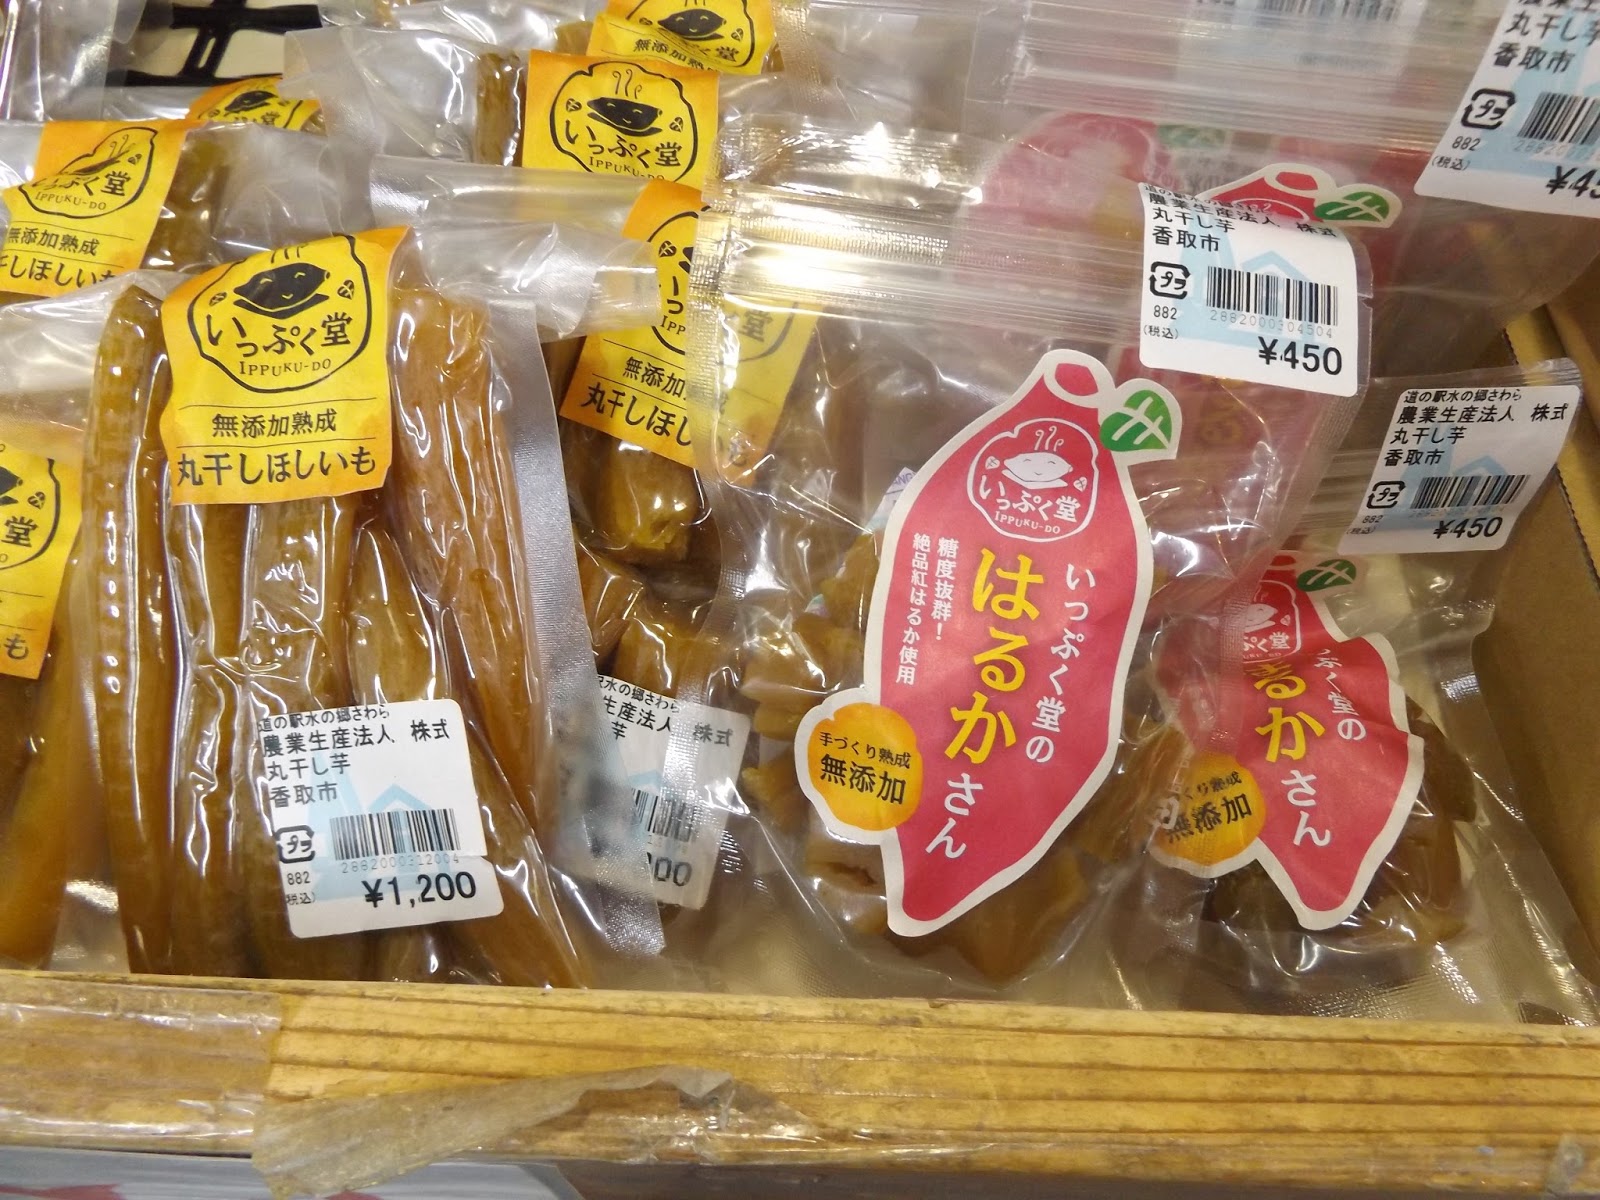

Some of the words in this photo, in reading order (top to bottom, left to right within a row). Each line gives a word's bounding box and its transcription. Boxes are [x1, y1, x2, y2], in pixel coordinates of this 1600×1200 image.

[634, 39, 718, 71] 無添加熟
[1494, 42, 1575, 73] 香取市
[565, 118, 682, 168] いっぷく堂
[1452, 136, 1481, 151] 882
[35, 191, 107, 211] IPPUKU-DO
[1152, 206, 1236, 233] 丸干し芋
[1152, 225, 1221, 252] 香取市
[1153, 305, 1178, 321] 882
[206, 312, 352, 357] いっぷく堂
[239, 358, 332, 377] IPPUKU-DO
[1258, 336, 1342, 376] ¥450
[622, 356, 688, 400] 無添加
[1404, 389, 1522, 402] 道の駅水の郷さわら
[212, 408, 338, 438] 無添加熟成
[581, 383, 692, 446] 丸干しほし
[1531, 403, 1568, 422] 株式
[1390, 427, 1467, 445] 丸干し芋
[177, 446, 376, 487] 丸干しほしいも
[1384, 449, 1445, 466] 香取市
[979, 474, 1081, 523] いっぷく堂
[994, 511, 1061, 534] IPPUKU-DO
[1433, 516, 1503, 539] ¥450
[896, 533, 931, 685] 絶品紅はるか使用
[258, 704, 390, 733] 道の駅水の郷さわら
[410, 718, 450, 741] 株式
[819, 732, 912, 770] 手づくり熟成
[268, 753, 351, 781] 丸干し芋
[820, 753, 907, 805] 無添加
[270, 782, 338, 808] 香取市
[286, 870, 311, 886] 882
[362, 871, 476, 908] ¥1,200
